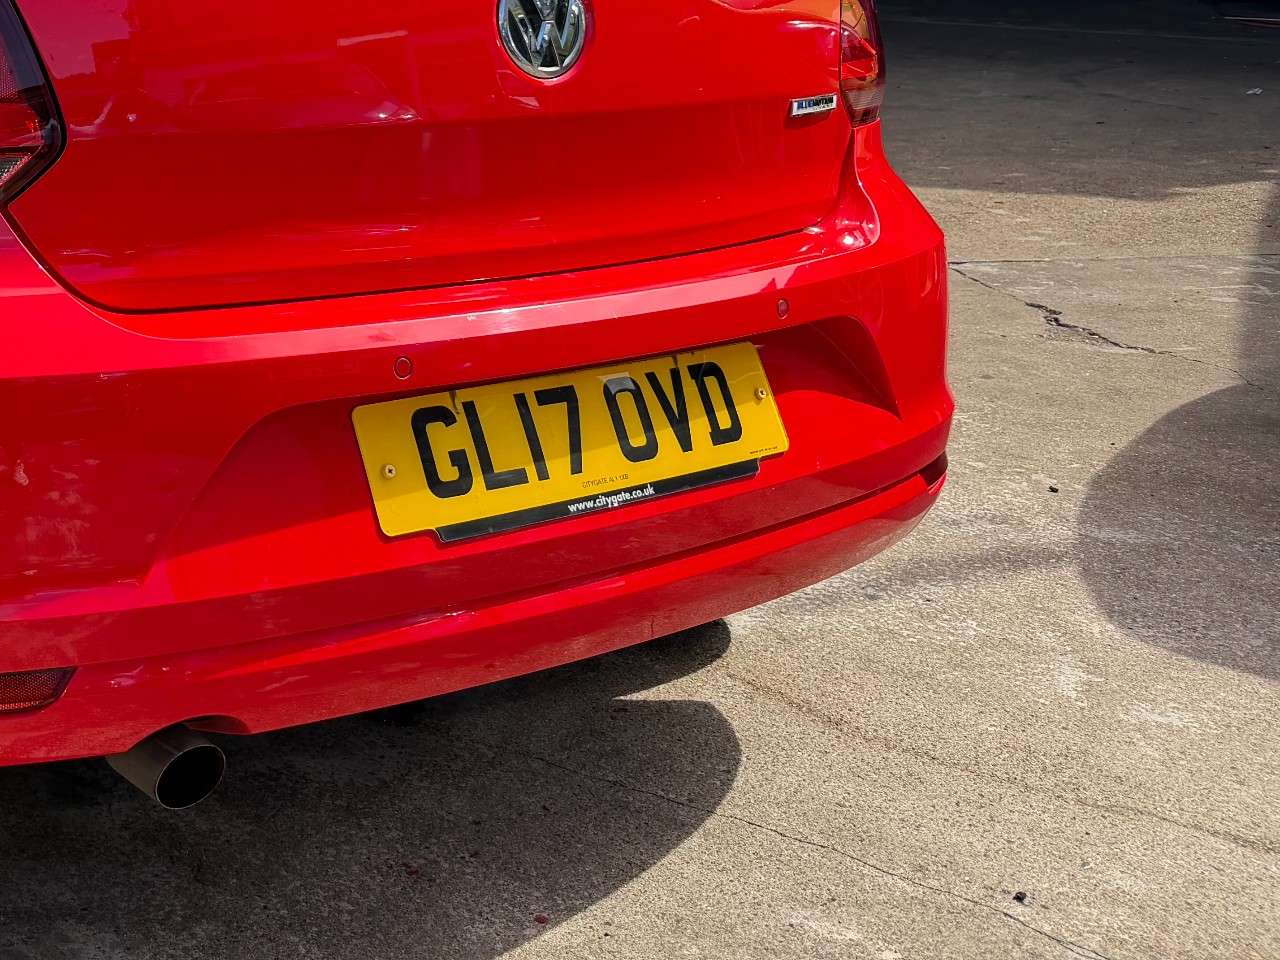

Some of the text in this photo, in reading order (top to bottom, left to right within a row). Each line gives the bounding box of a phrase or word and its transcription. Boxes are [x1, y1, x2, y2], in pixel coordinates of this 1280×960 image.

[410, 361, 743, 499] GL17 OVD
[568, 483, 655, 512] www.citygate.co.uk
